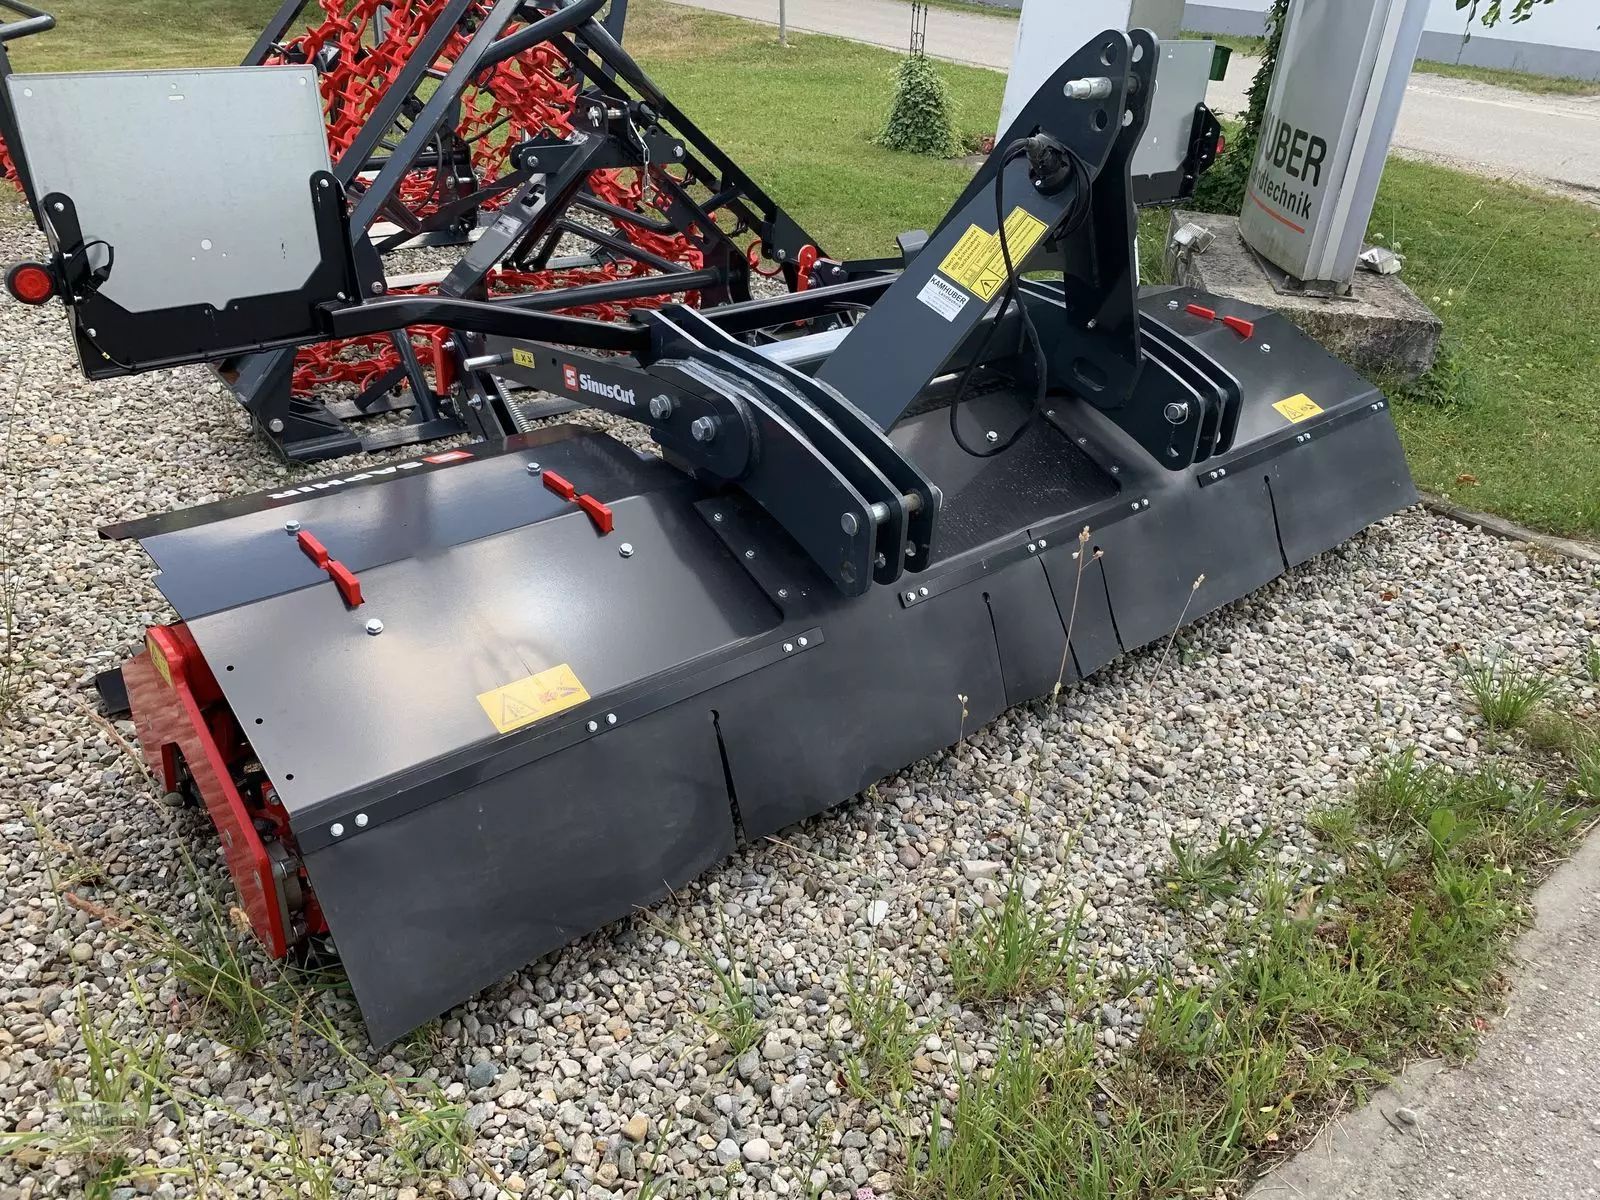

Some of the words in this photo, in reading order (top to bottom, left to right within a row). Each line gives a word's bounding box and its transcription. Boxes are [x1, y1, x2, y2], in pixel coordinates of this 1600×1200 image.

[1252, 166, 1312, 220] andtechnik
[930, 276, 966, 304] KAMHUBER
[580, 374, 636, 405] SinusCut
